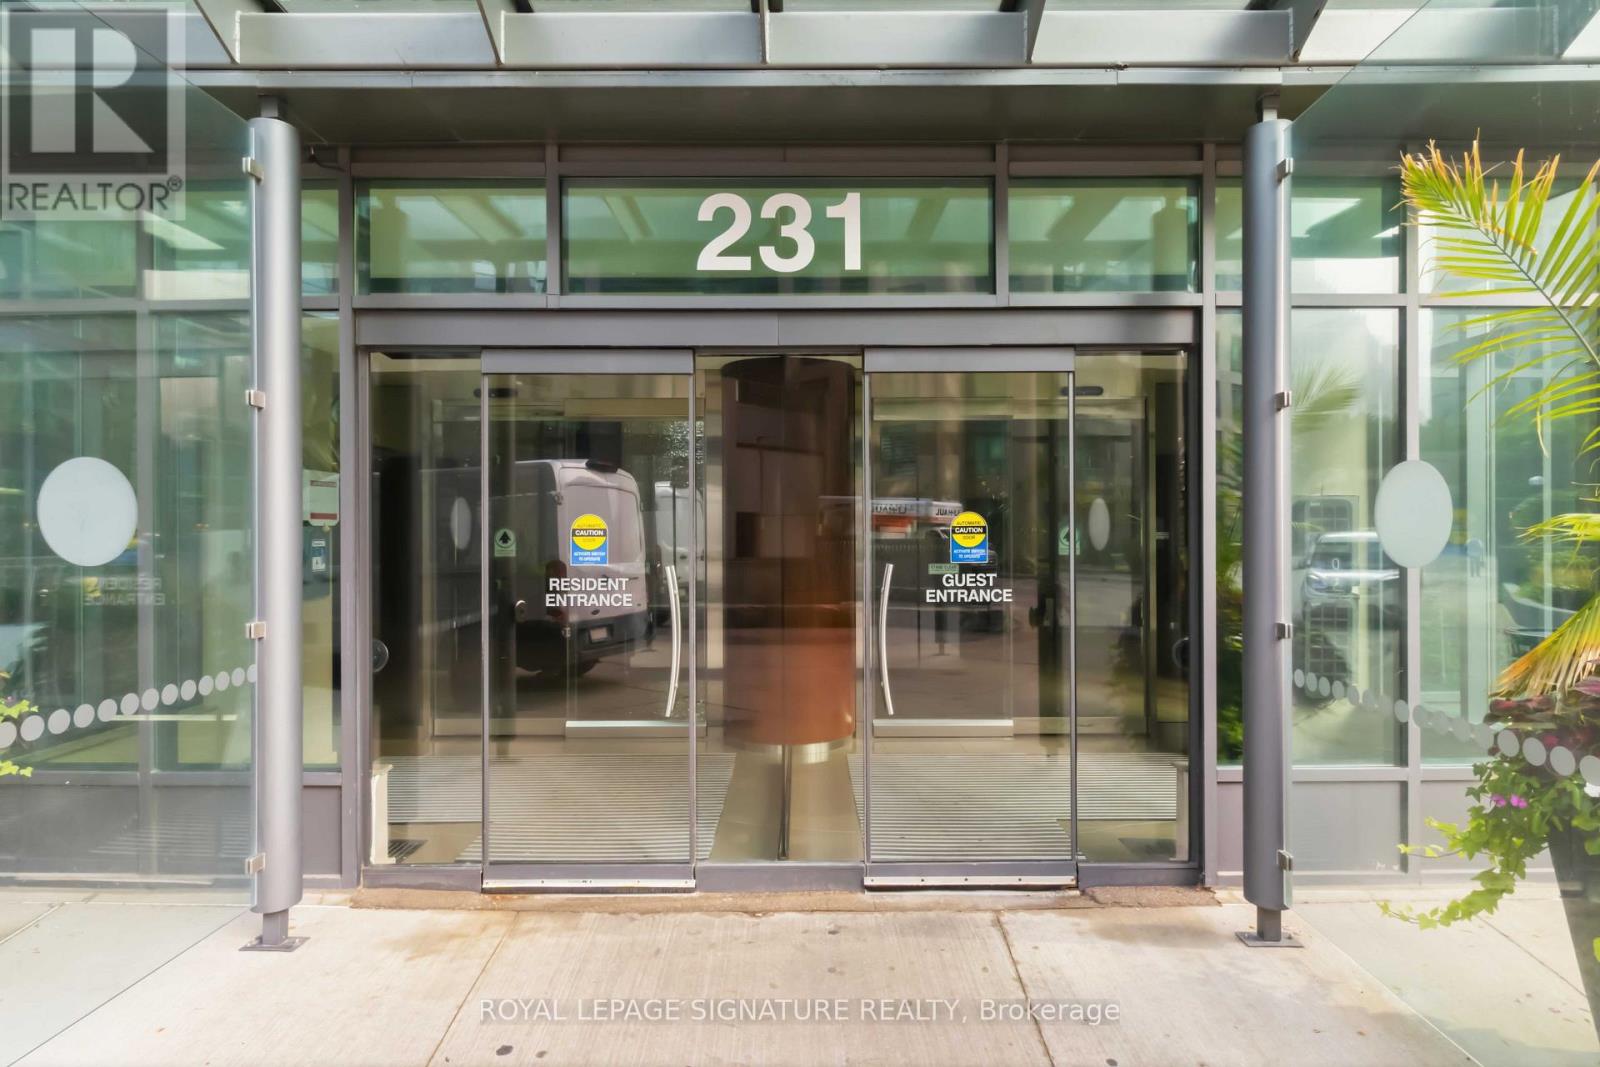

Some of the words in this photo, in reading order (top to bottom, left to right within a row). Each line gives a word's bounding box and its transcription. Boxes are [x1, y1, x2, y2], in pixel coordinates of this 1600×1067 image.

[696, 192, 862, 273] 231
[549, 578, 629, 591] RESIDENT
[942, 573, 997, 587] GUEST
[545, 593, 633, 607] ENTRANCE
[926, 589, 1013, 603] ENTRANCE
